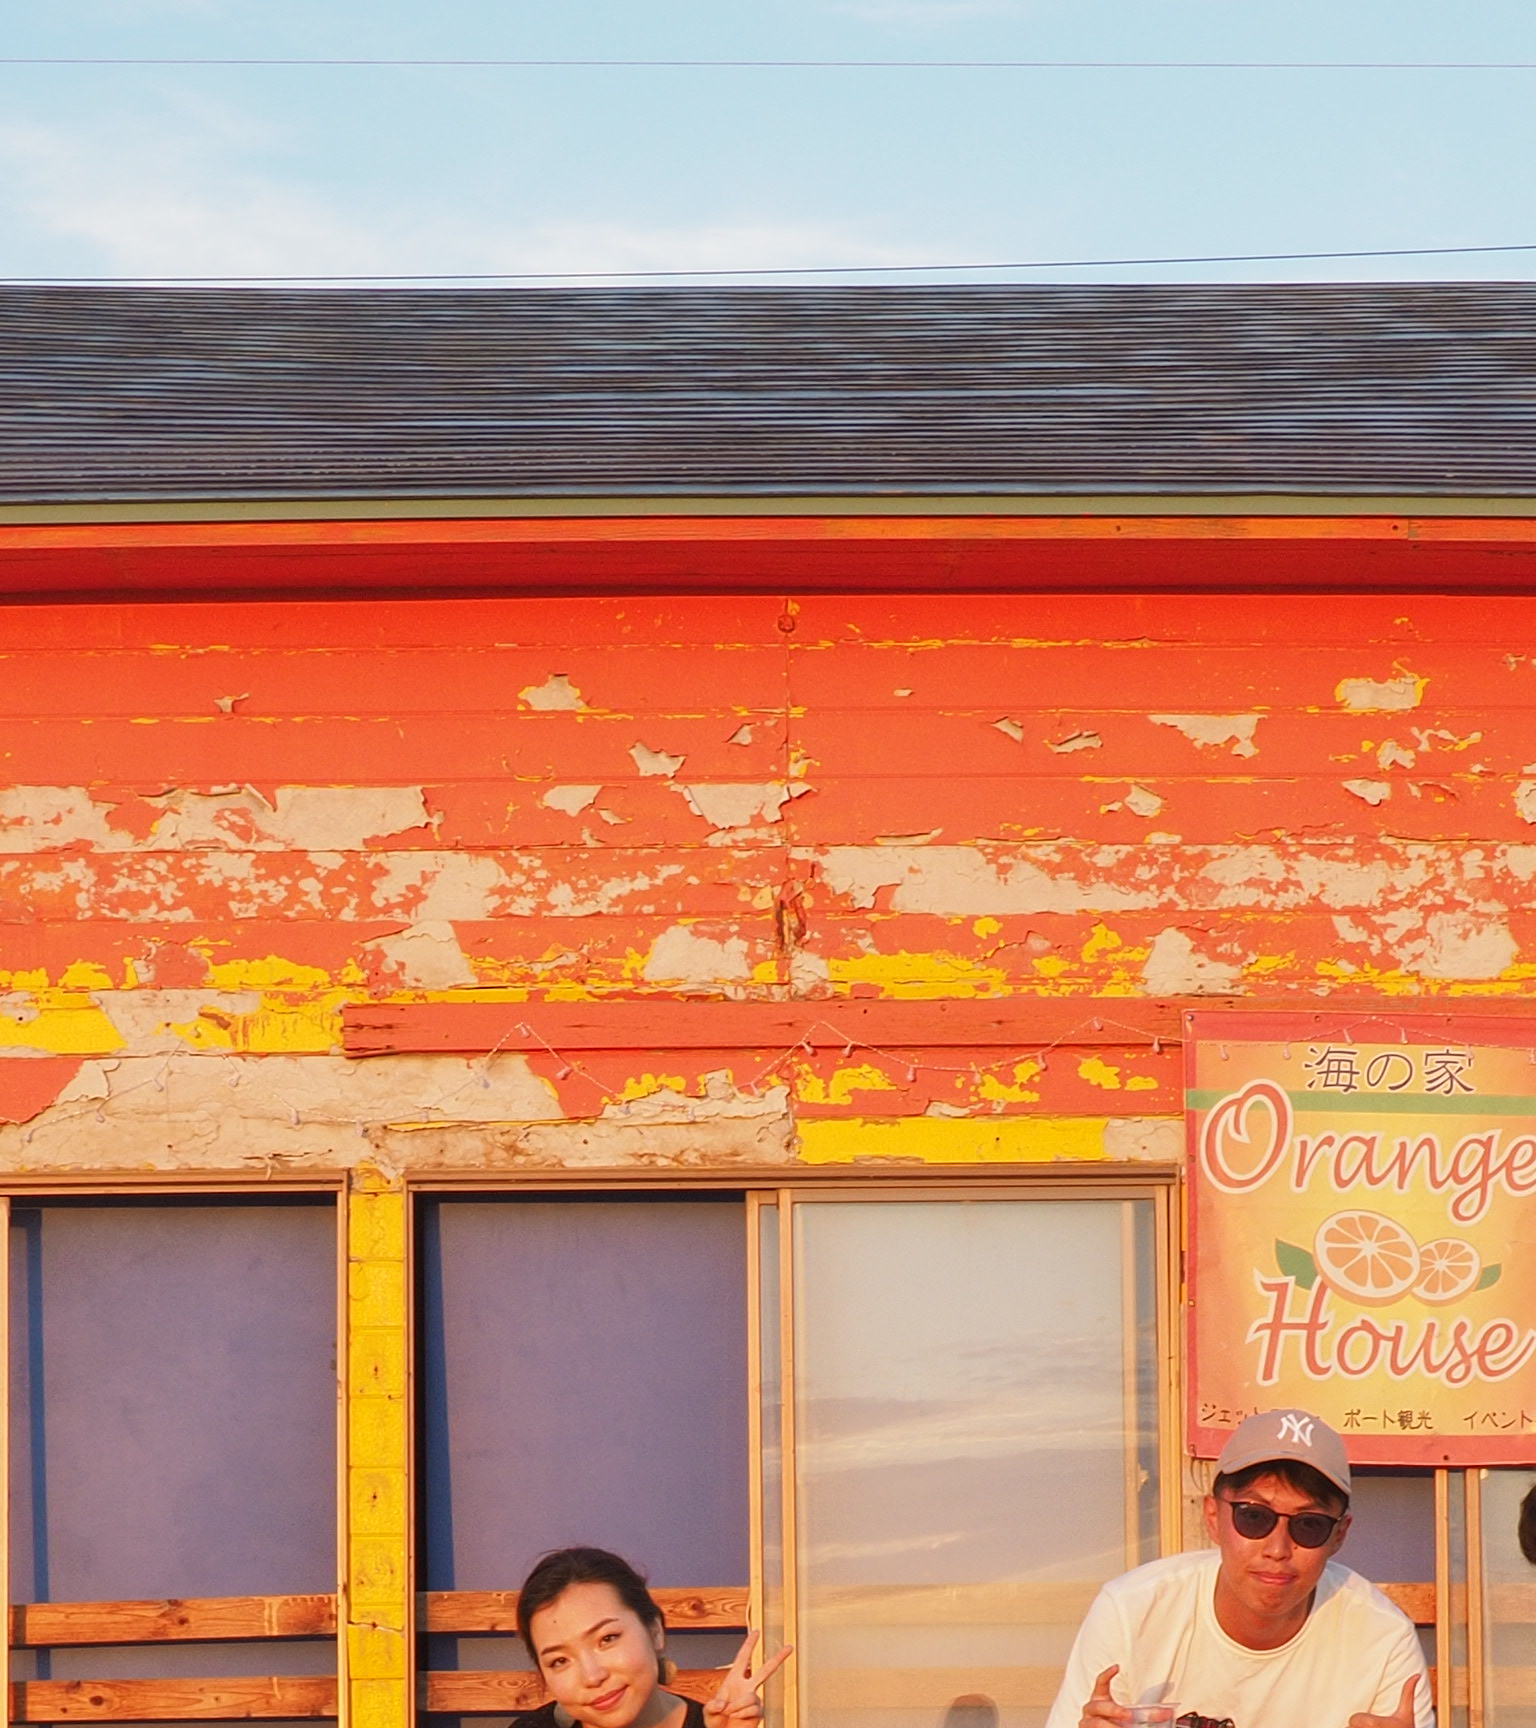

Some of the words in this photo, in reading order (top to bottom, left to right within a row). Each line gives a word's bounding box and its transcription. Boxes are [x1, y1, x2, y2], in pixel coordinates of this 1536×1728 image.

[1304, 1046, 1475, 1094] 海の家
[1276, 1412, 1315, 1447] NY
